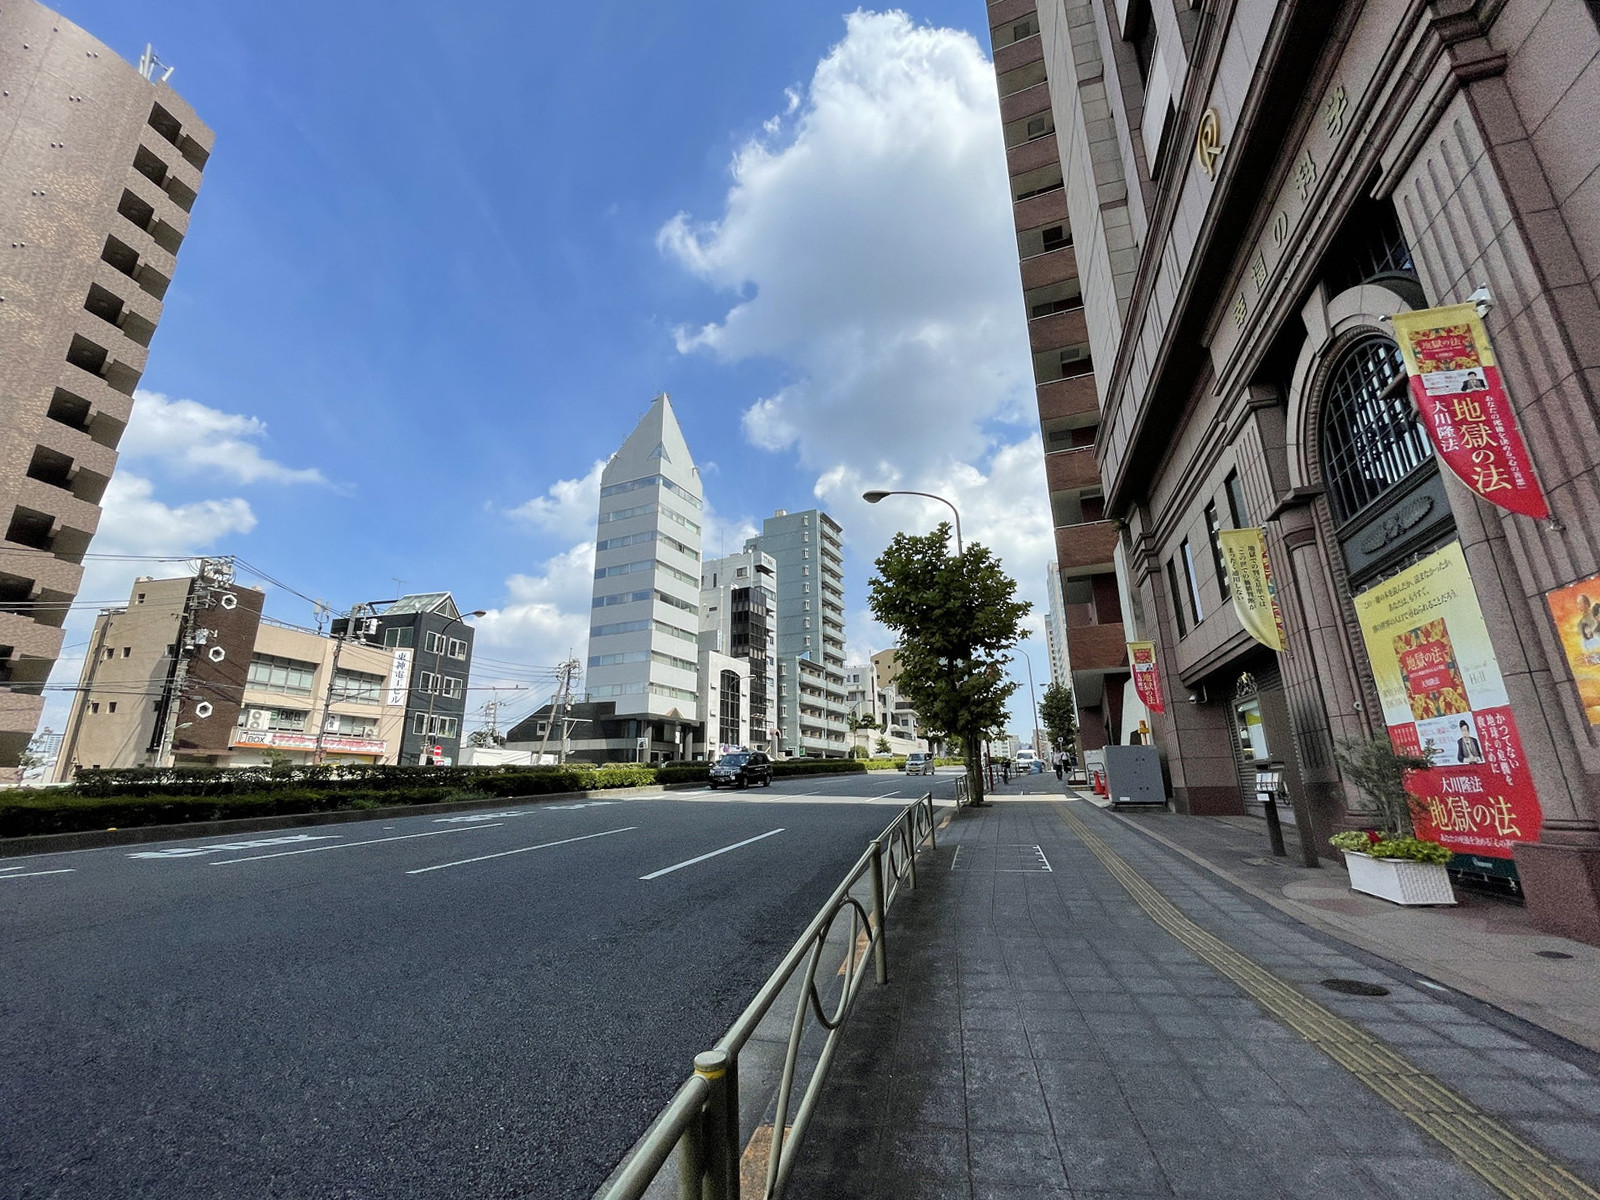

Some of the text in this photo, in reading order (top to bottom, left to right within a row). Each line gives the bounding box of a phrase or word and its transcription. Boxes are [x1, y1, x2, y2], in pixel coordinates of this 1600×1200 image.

[1233, 85, 1348, 329] 幸福の科学
[1432, 400, 1460, 453] 大川隆法
[1450, 397, 1513, 494] 地獄の法
[1405, 646, 1444, 671] 地獄の法
[1477, 716, 1500, 774] 救うために
[1486, 714, 1514, 786] 地球の危機を
[1495, 713, 1519, 769] かつてない
[1441, 776, 1484, 794] 大川隆法
[1427, 795, 1522, 837] 地獄の法
